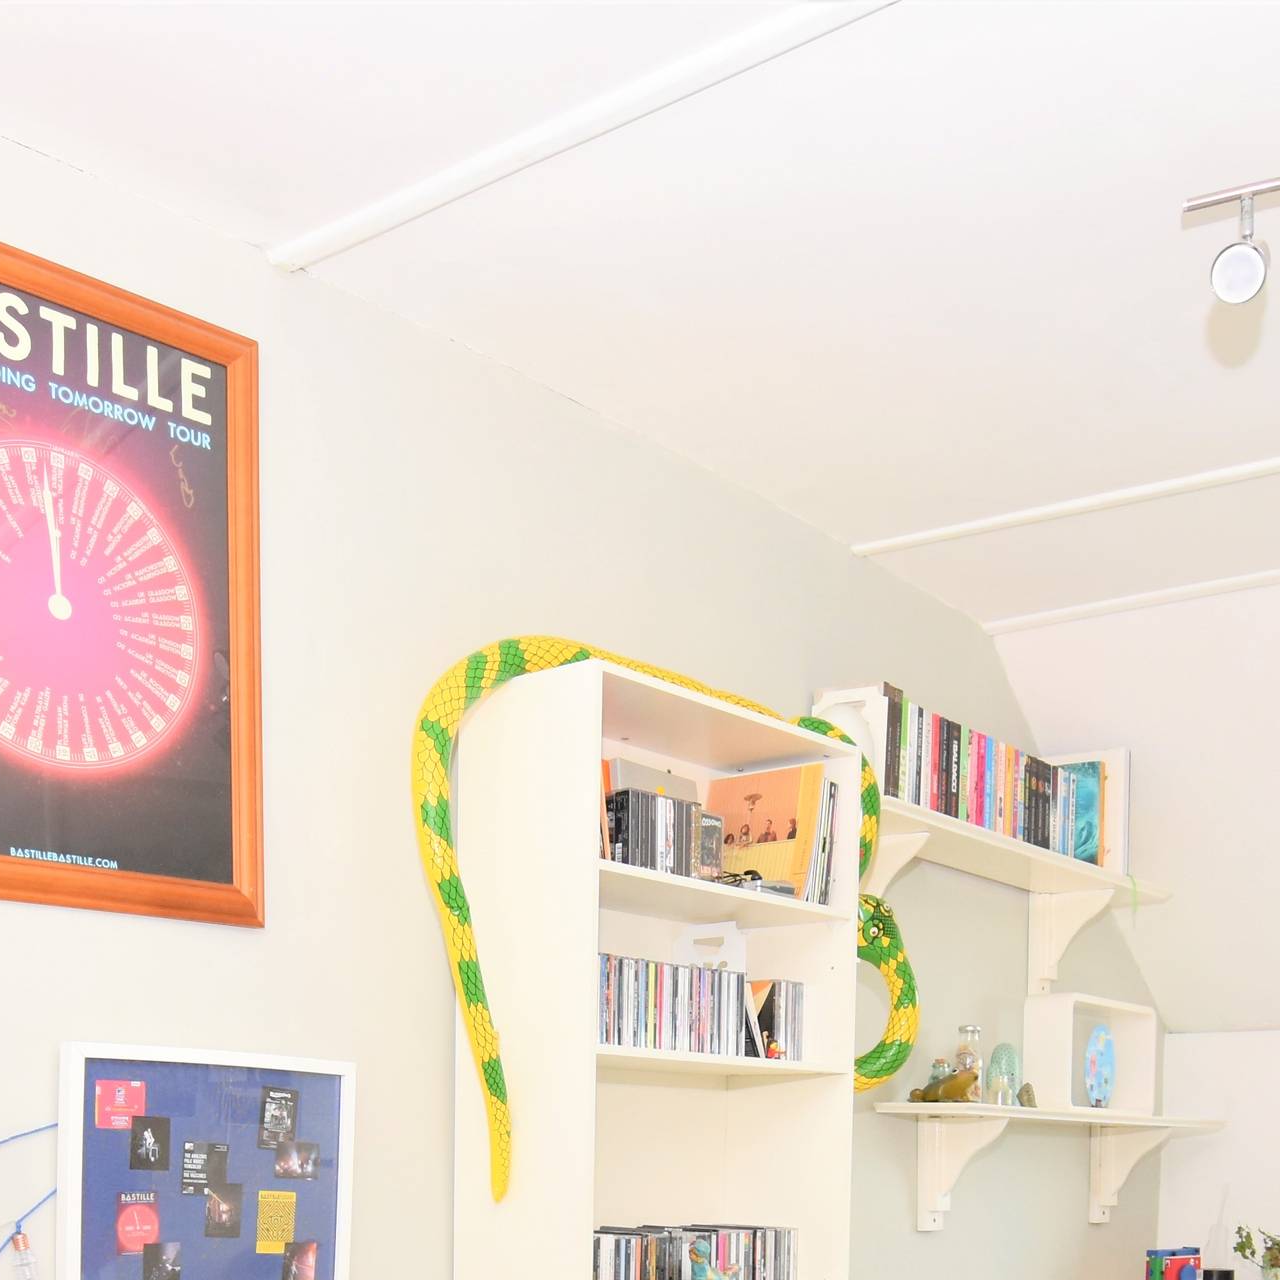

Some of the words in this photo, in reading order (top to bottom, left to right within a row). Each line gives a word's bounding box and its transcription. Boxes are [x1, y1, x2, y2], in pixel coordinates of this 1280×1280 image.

[48, 382, 156, 431] TOMORROW
[168, 421, 212, 450] TOUR
[10, 846, 118, 870] BASTILLEBASTILLE.COM
[121, 1192, 156, 1201] BASTILLE
